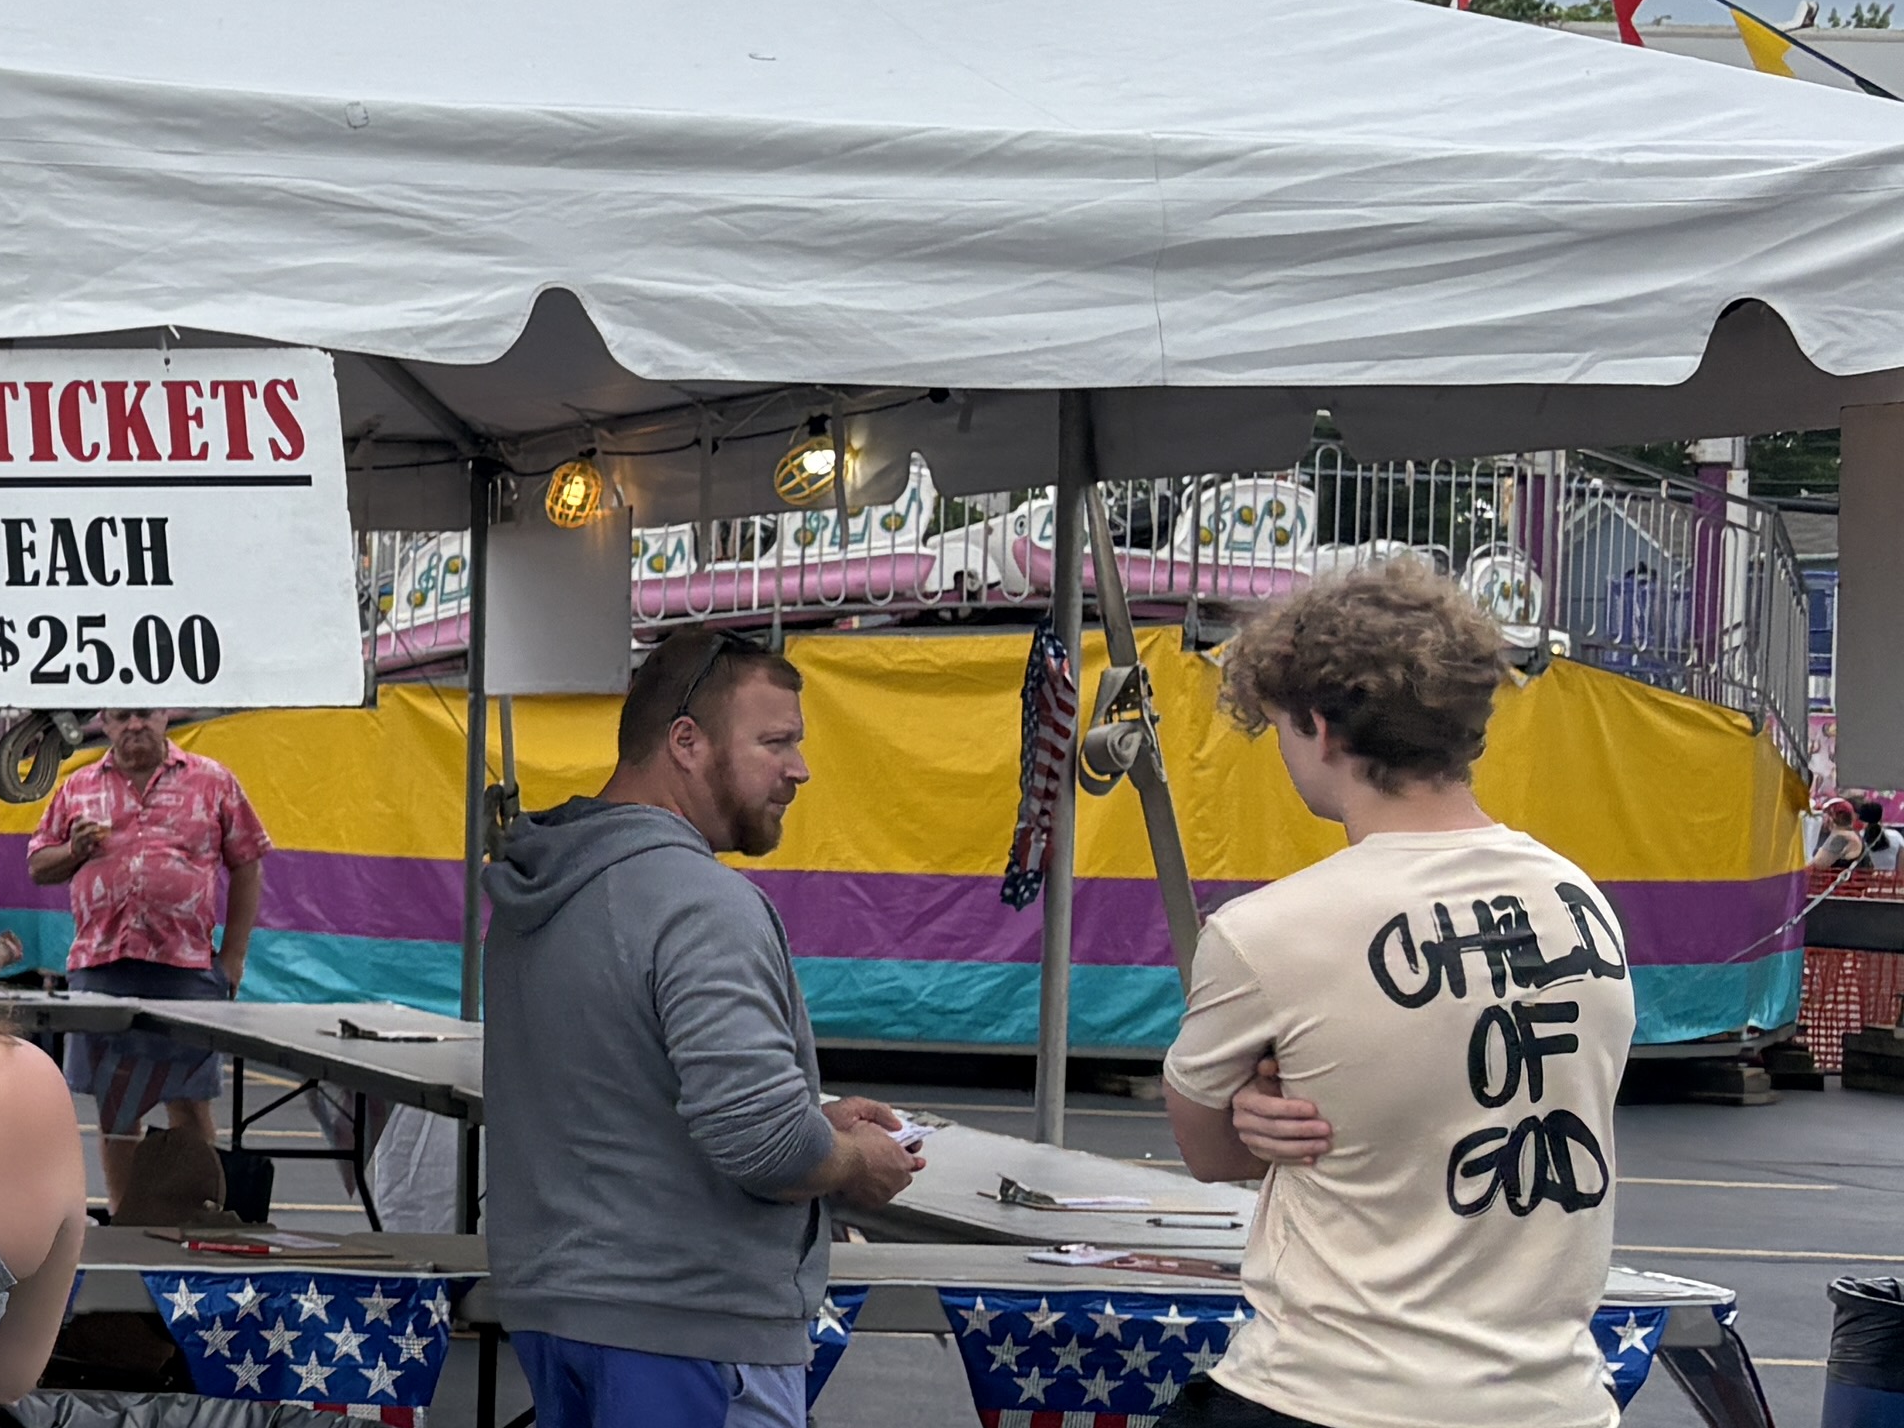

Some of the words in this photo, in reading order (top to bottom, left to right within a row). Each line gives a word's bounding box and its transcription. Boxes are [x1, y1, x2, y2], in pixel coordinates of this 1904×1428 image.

[2, 516, 174, 586] EACH
[1367, 882, 1627, 1009] CHILD
[1467, 1001, 1580, 1109] OF
[1447, 1109, 1610, 1218] GOD
